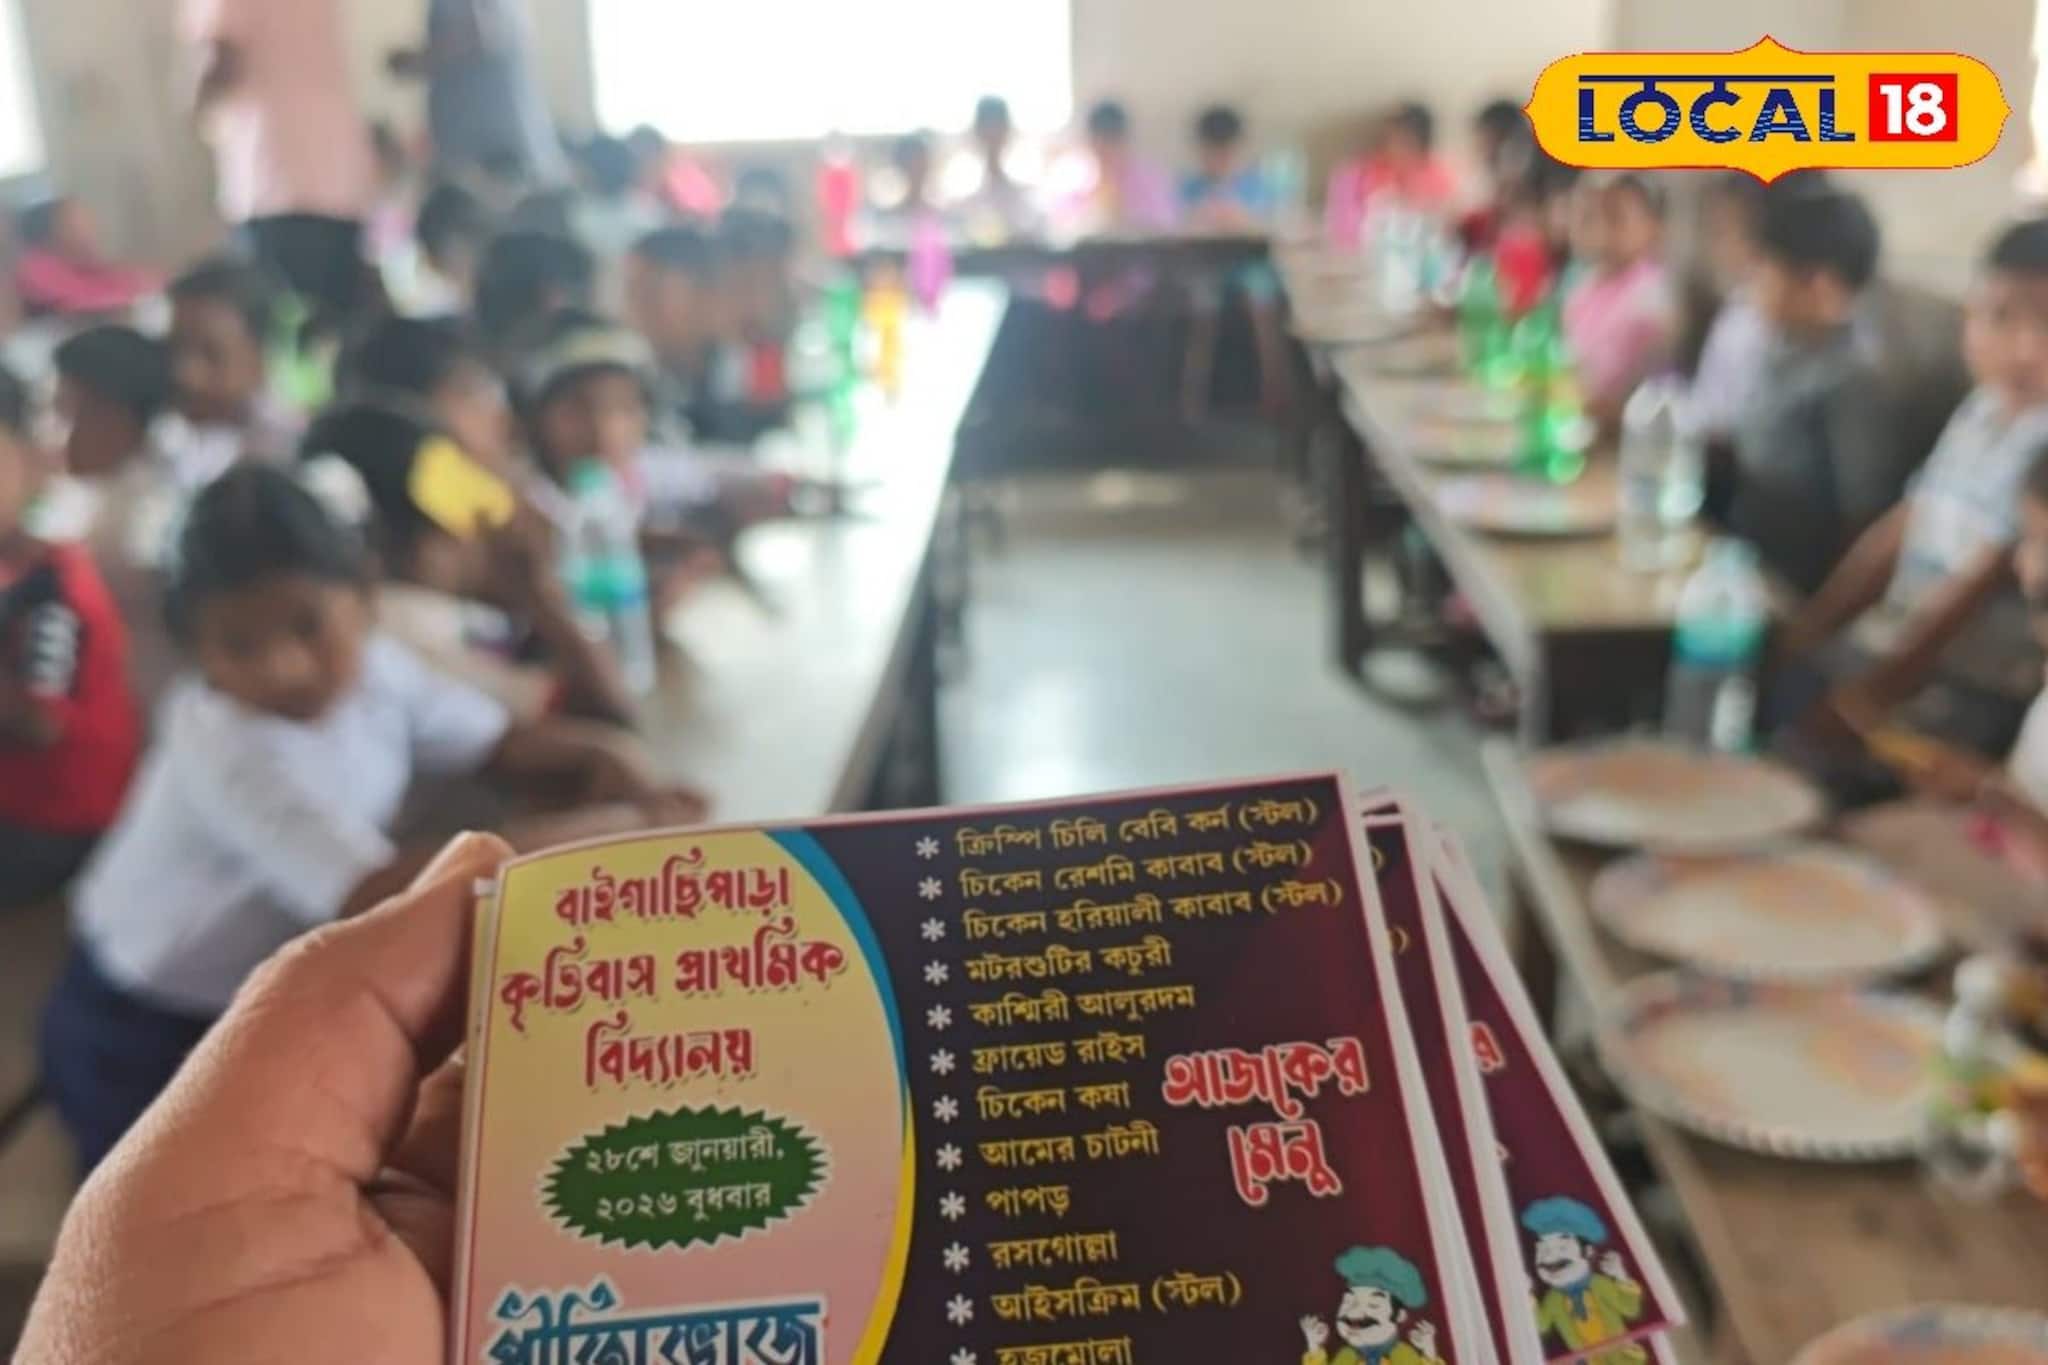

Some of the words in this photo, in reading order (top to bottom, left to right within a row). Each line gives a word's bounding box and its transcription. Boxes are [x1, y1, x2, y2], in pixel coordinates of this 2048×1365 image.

[1050, 820, 1107, 850] চিলি
[1119, 810, 1178, 842] বেবি
[1238, 798, 1320, 831] (স্টল)
[960, 868, 1042, 899] চিকেন
[1054, 856, 1136, 891] রেশমি
[1144, 850, 1224, 880] কাবাব
[1233, 840, 1314, 872] (স্টল)
[963, 909, 1047, 941] চিকেন
[1056, 894, 1163, 934] হরিয়ালী
[1171, 888, 1252, 921] কাবাব
[1262, 880, 1343, 913] (স্টল)
[675, 916, 845, 993] প্রাথমিক
[1100, 935, 1172, 976] কচুরী
[1076, 984, 1195, 1022] আলুরদম
[585, 1010, 754, 1087] বিদ্যালয়
[1073, 1030, 1146, 1065] রাইস
[977, 1086, 1067, 1121] চিকেন
[1162, 1037, 1370, 1121] আজকের
[585, 1143, 660, 1174] ২৮শে
[978, 1133, 1076, 1169] আমের
[1083, 1119, 1161, 1160] চাটনী
[1227, 1118, 1343, 1206] মেনু
[595, 1191, 679, 1222] ২০২৬
[683, 1182, 772, 1221] বুধবার
[985, 1183, 1071, 1219] পাপড়
[990, 1275, 1142, 1322] আইসক্রিম
[1151, 1269, 1243, 1314] (স্টল)
